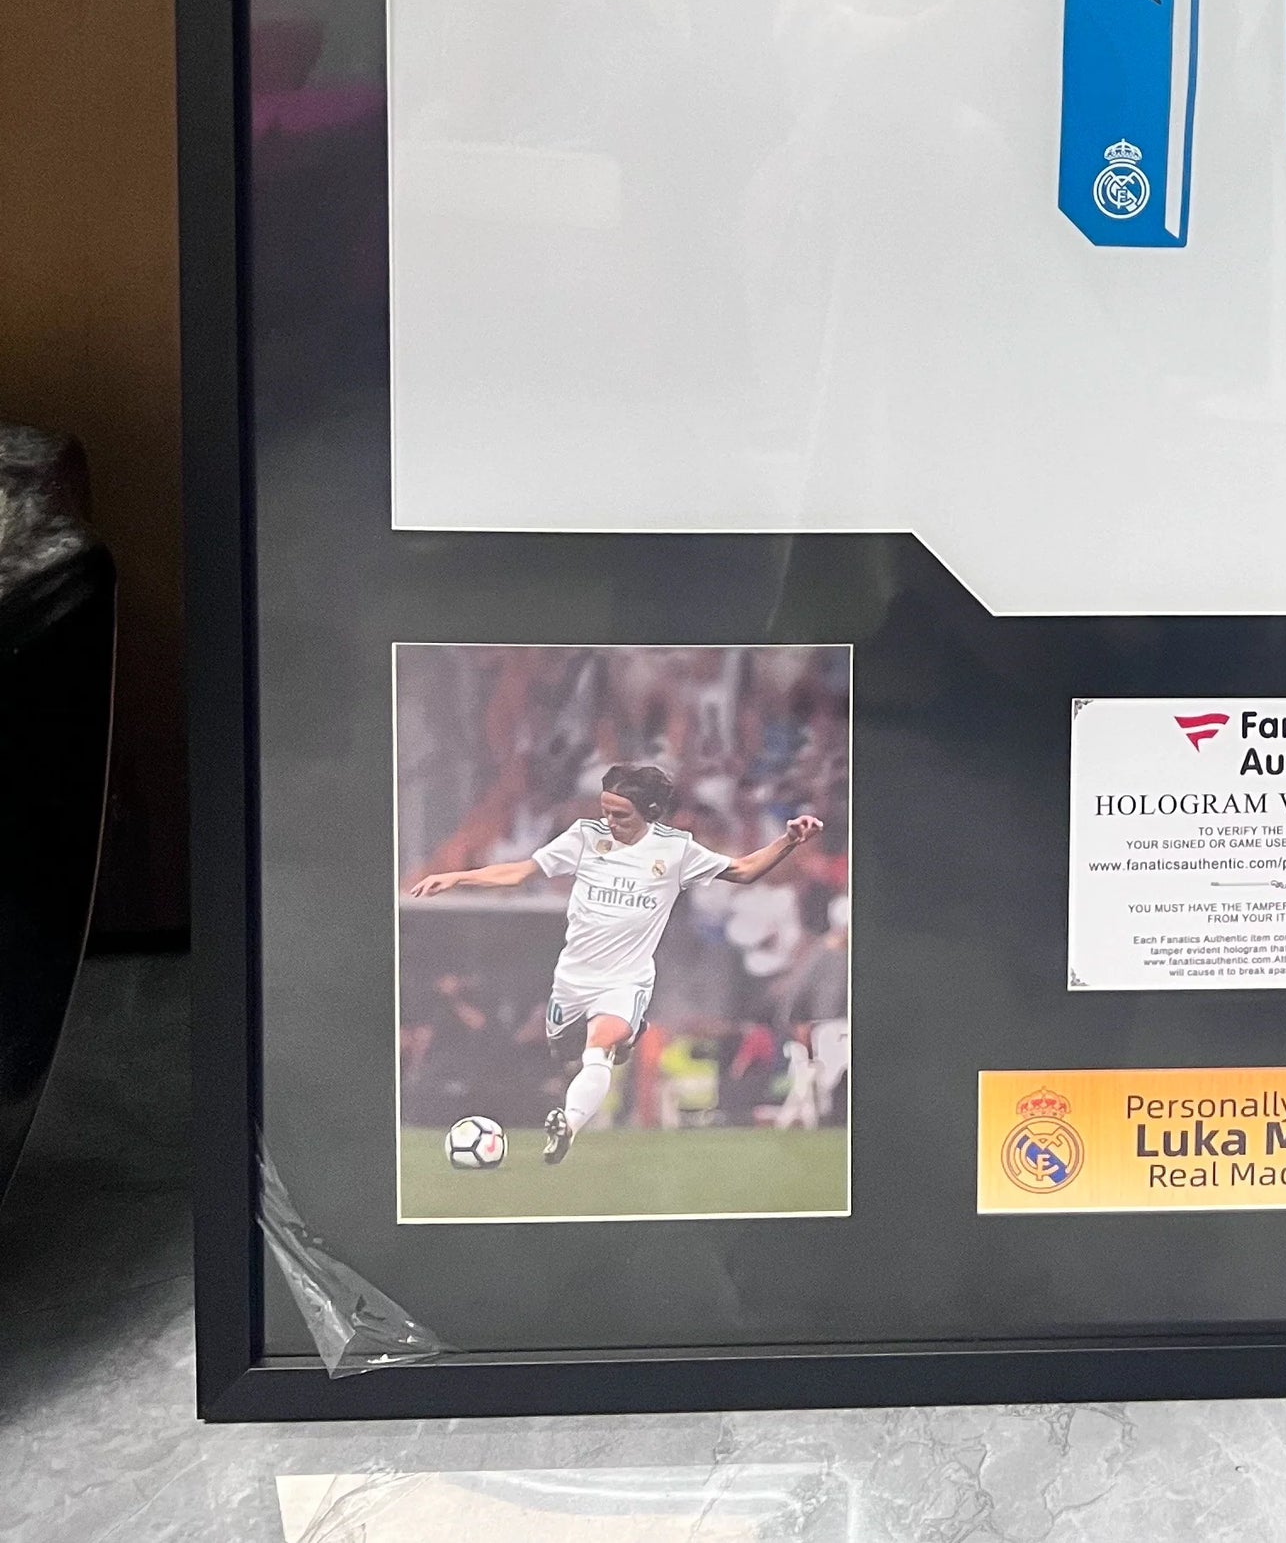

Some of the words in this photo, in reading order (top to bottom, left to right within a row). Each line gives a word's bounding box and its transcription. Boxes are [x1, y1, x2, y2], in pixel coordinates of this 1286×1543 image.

[1094, 792, 1268, 816] HOLOGRAM
[1198, 826, 1213, 836] TO
[1216, 825, 1258, 836] VERIFY
[1261, 825, 1283, 835] THE
[1125, 839, 1158, 849] YOUR
[1162, 839, 1205, 849] SIGNED
[1209, 838, 1225, 848] OR
[1229, 838, 1261, 848] GAME
[613, 876, 636, 892] Fly
[587, 885, 658, 910] Emirates
[1128, 903, 1151, 913] YOU
[1154, 903, 1184, 912] MUST
[1188, 902, 1217, 912] HAVE
[1221, 902, 1241, 912] THE
[1207, 913, 1238, 923] FROM
[1242, 913, 1272, 922] YOUR
[1133, 935, 1157, 944] Each
[1160, 934, 1200, 944] Fanatics
[1203, 934, 1247, 943] Authentic
[1250, 934, 1270, 942] item
[1150, 947, 1183, 956] tamper
[1186, 946, 1220, 954] evident
[1223, 945, 1267, 955] hologram
[1169, 968, 1184, 976] will
[1238, 967, 1265, 975] break
[1136, 1120, 1247, 1157] Luka
[1149, 1161, 1219, 1188] Real
